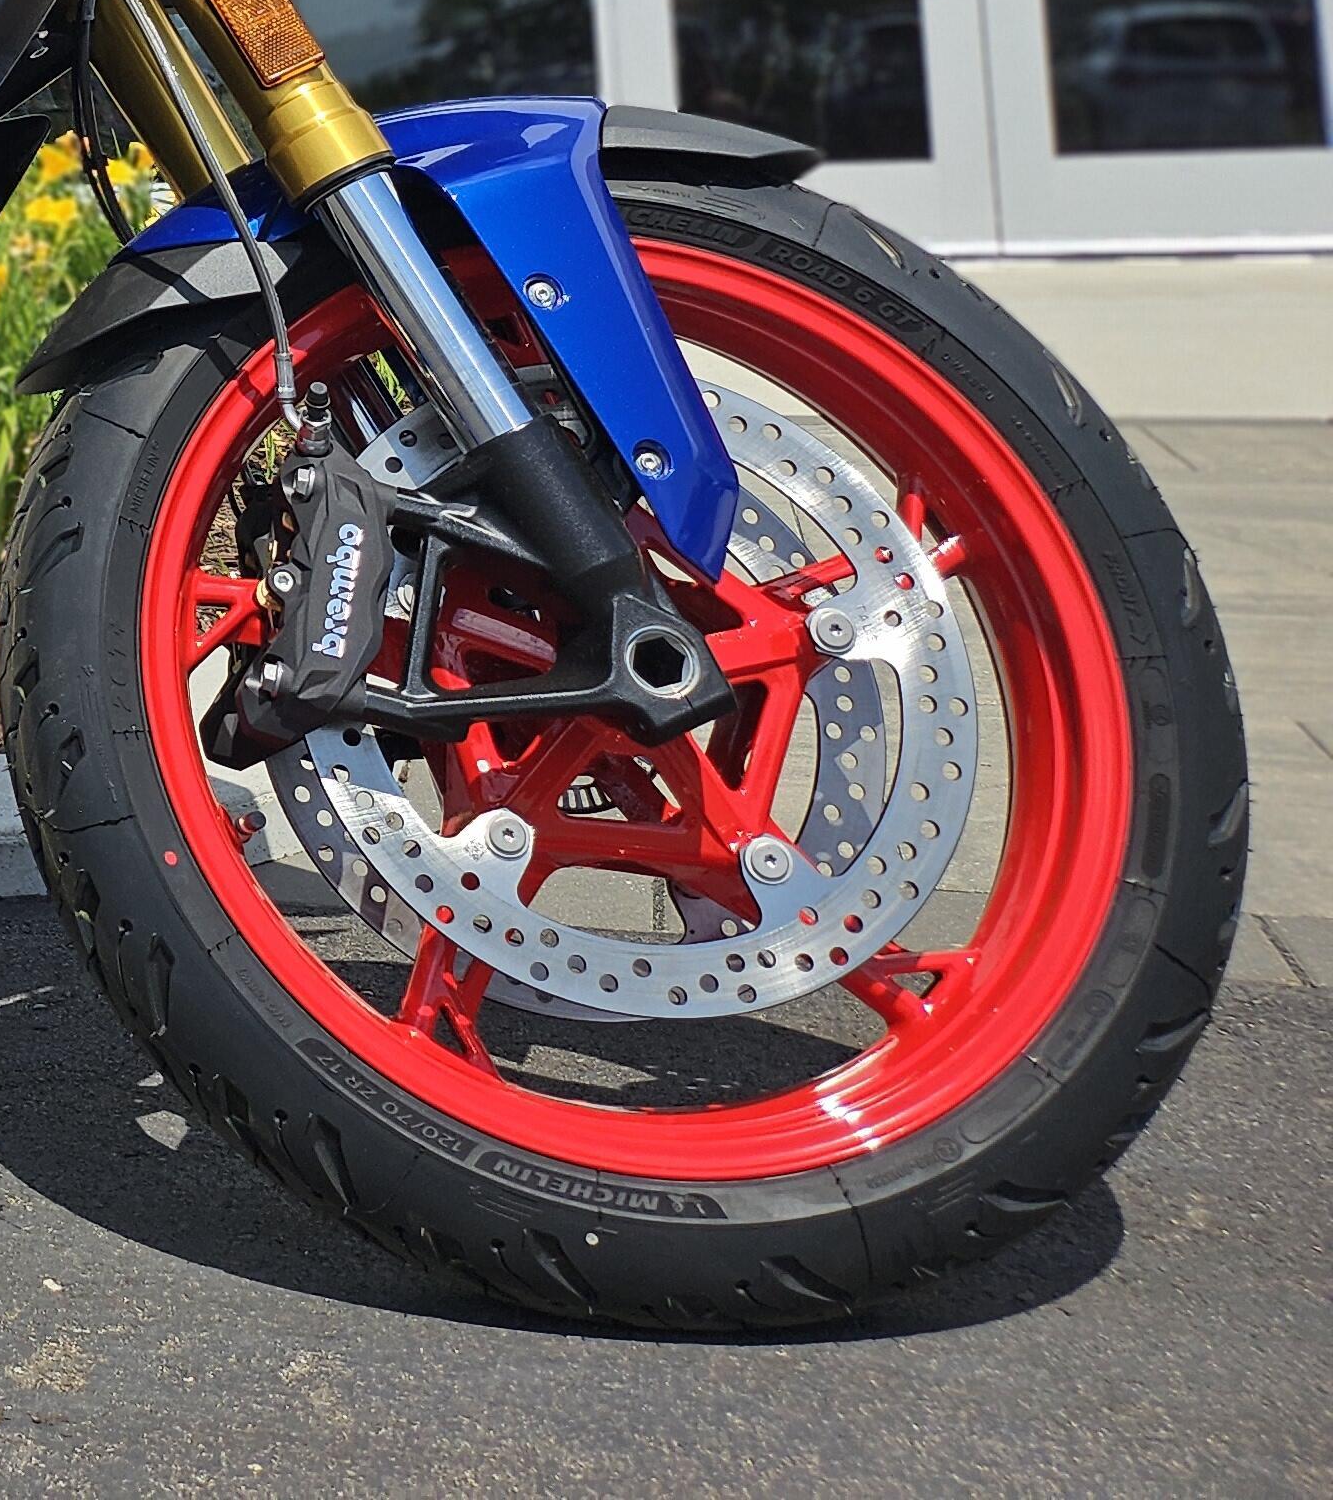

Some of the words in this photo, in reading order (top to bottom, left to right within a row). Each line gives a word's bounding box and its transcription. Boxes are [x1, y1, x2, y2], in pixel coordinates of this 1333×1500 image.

[627, 207, 740, 248] CHELIN
[771, 246, 854, 294] ROAD
[878, 299, 923, 328] GT
[131, 453, 157, 517] MICHELIN
[311, 522, 366, 659] brembo
[315, 1052, 341, 1078] 17
[343, 1072, 379, 1100] ZR
[382, 1102, 465, 1156] 120/70
[492, 1157, 661, 1214] MICHELIN
